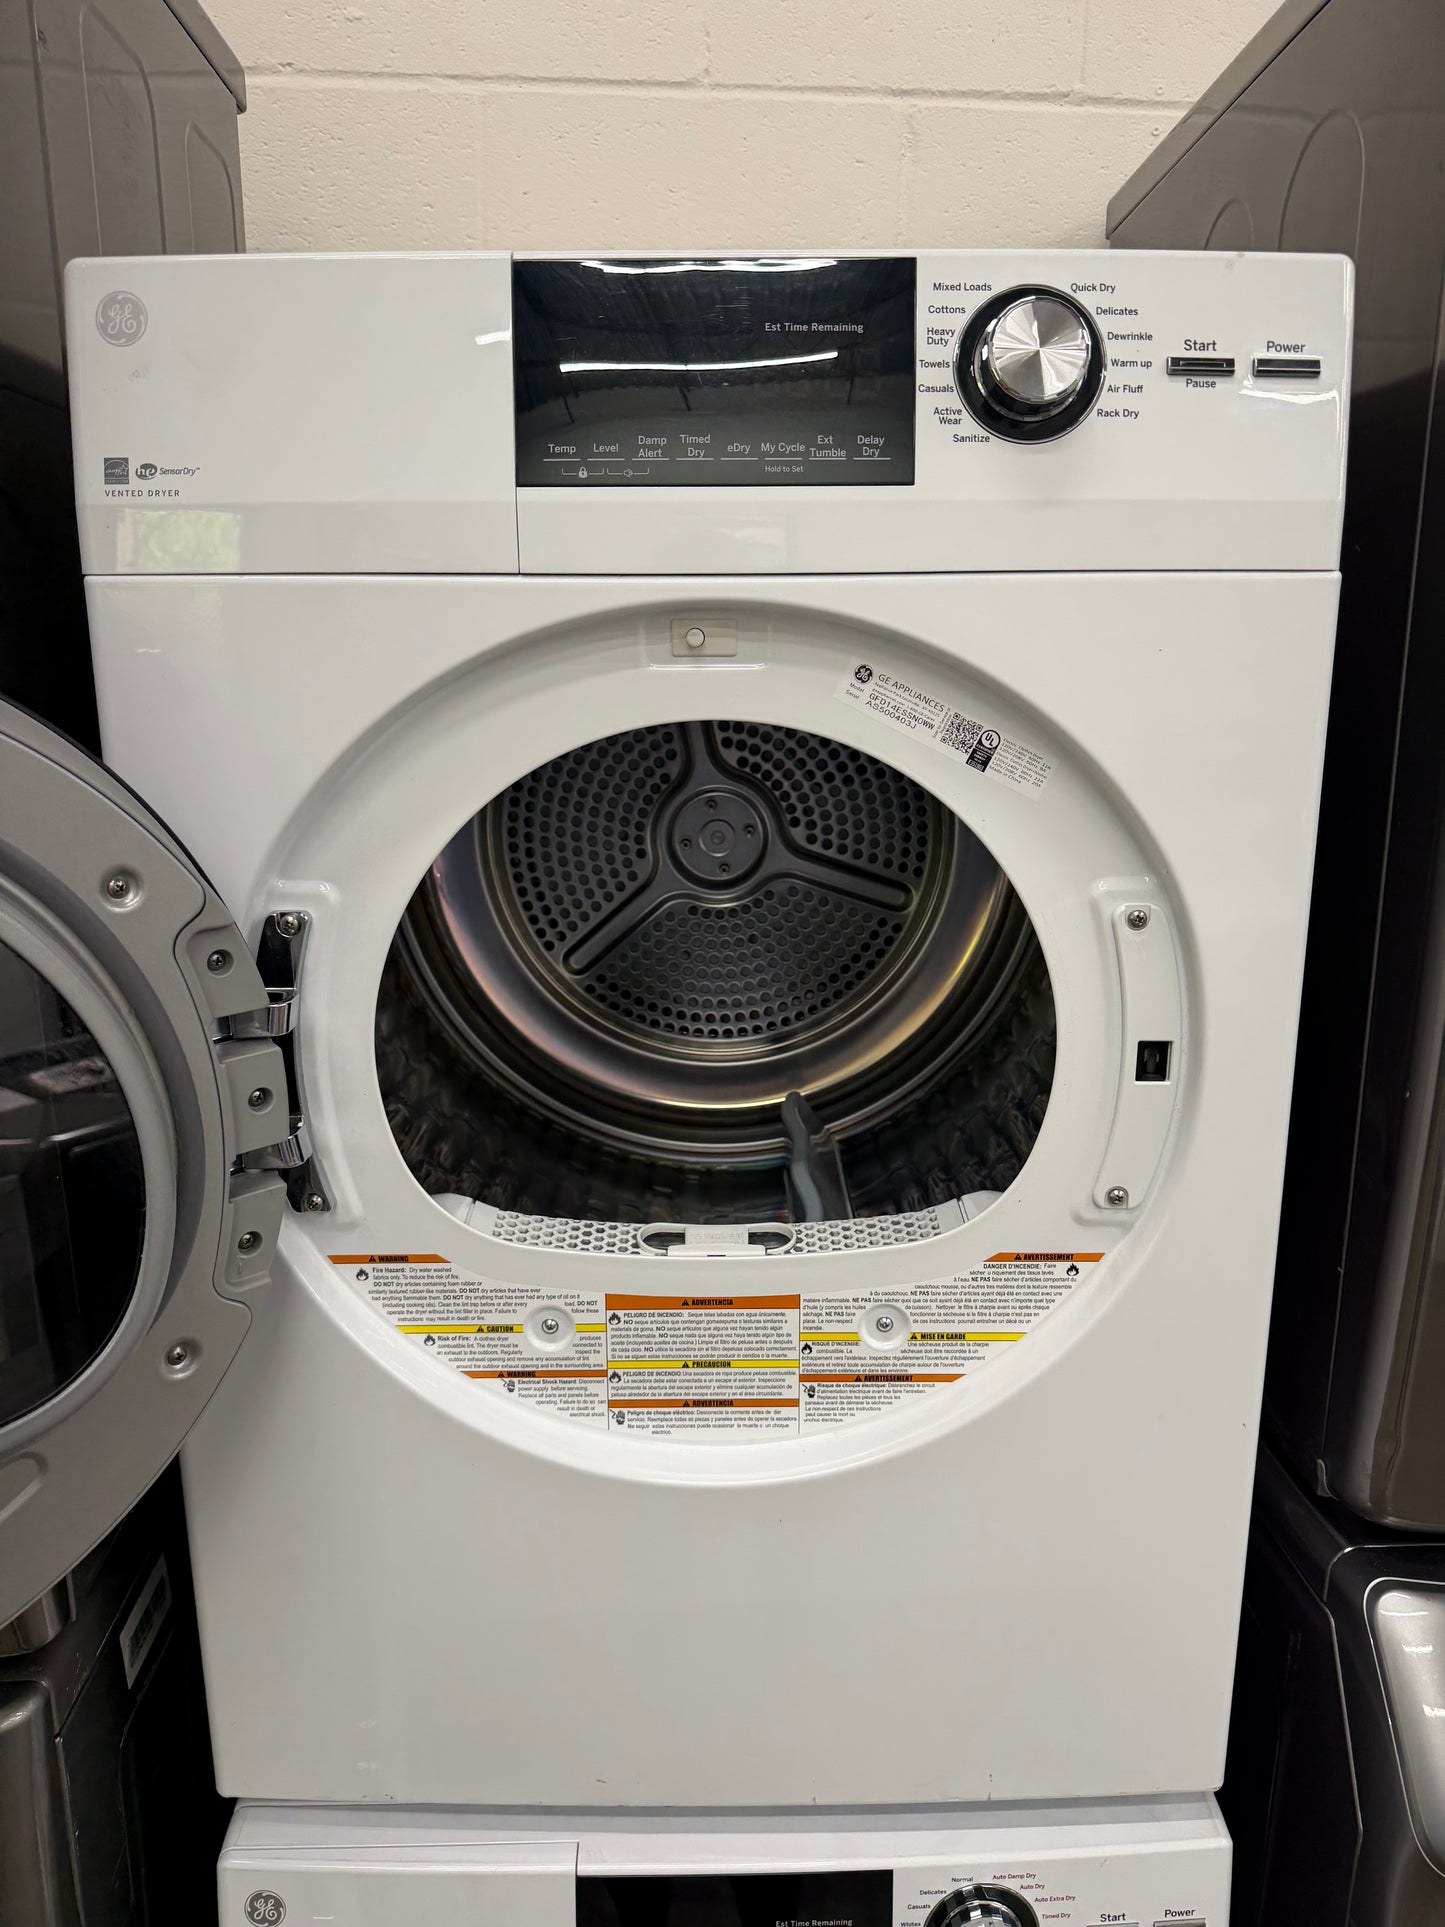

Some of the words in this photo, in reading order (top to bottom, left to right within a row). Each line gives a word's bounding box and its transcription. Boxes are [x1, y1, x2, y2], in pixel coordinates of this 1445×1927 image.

[933, 282, 961, 291] Mixed
[963, 282, 992, 291] Loads
[1070, 283, 1097, 294] Quick
[1099, 283, 1116, 294] Dry
[928, 305, 966, 313] Cottons
[1096, 306, 1138, 315] Delicates
[765, 322, 780, 331] Est
[783, 322, 808, 331] Time
[810, 322, 864, 333] Remaining
[927, 327, 955, 338] Heavy
[1107, 332, 1153, 340] Dewrinkle
[927, 336, 948, 347] Duty
[1184, 339, 1217, 351] Start
[1266, 341, 1305, 352] Power
[919, 359, 950, 368] Towels
[1111, 358, 1138, 367] Warm
[1140, 360, 1152, 369] up
[918, 384, 954, 392] Casuals
[1107, 384, 1119, 393] Air
[1122, 384, 1144, 393] Fluff
[1185, 379, 1216, 388] Pause
[933, 406, 962, 415] Active
[1096, 408, 1120, 417] Rack
[1122, 408, 1139, 419] Dry
[938, 416, 962, 424] Wear
[638, 435, 666, 446] Damp
[680, 434, 710, 443] Timed
[817, 435, 833, 444] Ext
[857, 435, 884, 446] Delay
[952, 433, 990, 442] Sanitize
[548, 444, 576, 455] Temp
[593, 443, 619, 452] Level
[638, 447, 662, 456] Alert
[687, 447, 705, 458] Dry
[727, 443, 751, 454] eDry
[761, 442, 775, 454] My
[777, 442, 805, 454] Cycle
[810, 447, 846, 456] Tumble
[862, 446, 880, 457] Dry
[878, 674, 892, 685] GE
[892, 680, 945, 712] APPLIANCES
[865, 700, 916, 729] AS500403J
[985, 733, 994, 746] UL
[1008, 774, 1021, 784] China
[1100, 1911, 1126, 1921] Start
[1164, 1907, 1195, 1917] Power
[811, 1919, 853, 1927] Remaining
